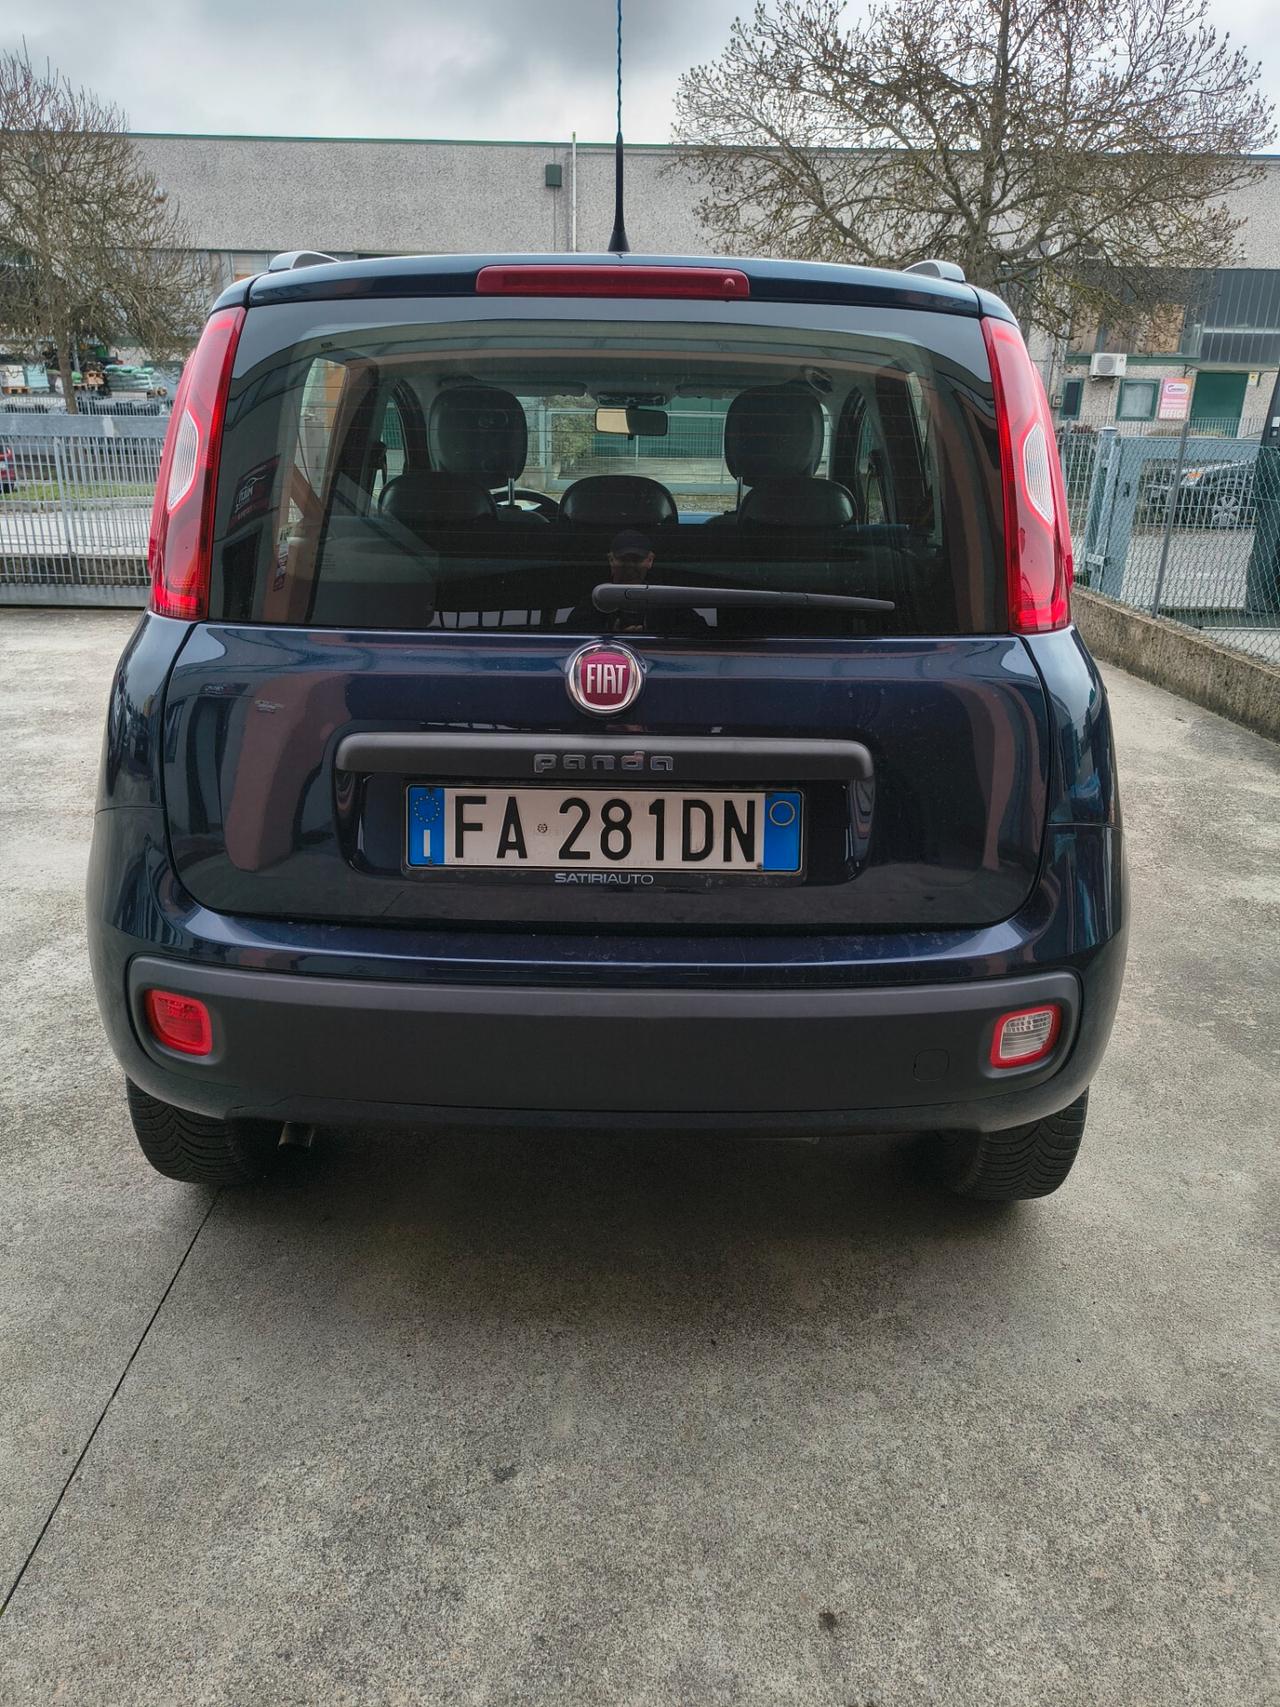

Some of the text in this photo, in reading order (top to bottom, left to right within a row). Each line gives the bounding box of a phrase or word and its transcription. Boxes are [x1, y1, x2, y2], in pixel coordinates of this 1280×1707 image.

[586, 663, 627, 694] FIAT
[533, 751, 674, 773] panda
[455, 795, 528, 859] FA
[554, 873, 654, 885] SATIRIAUTO
